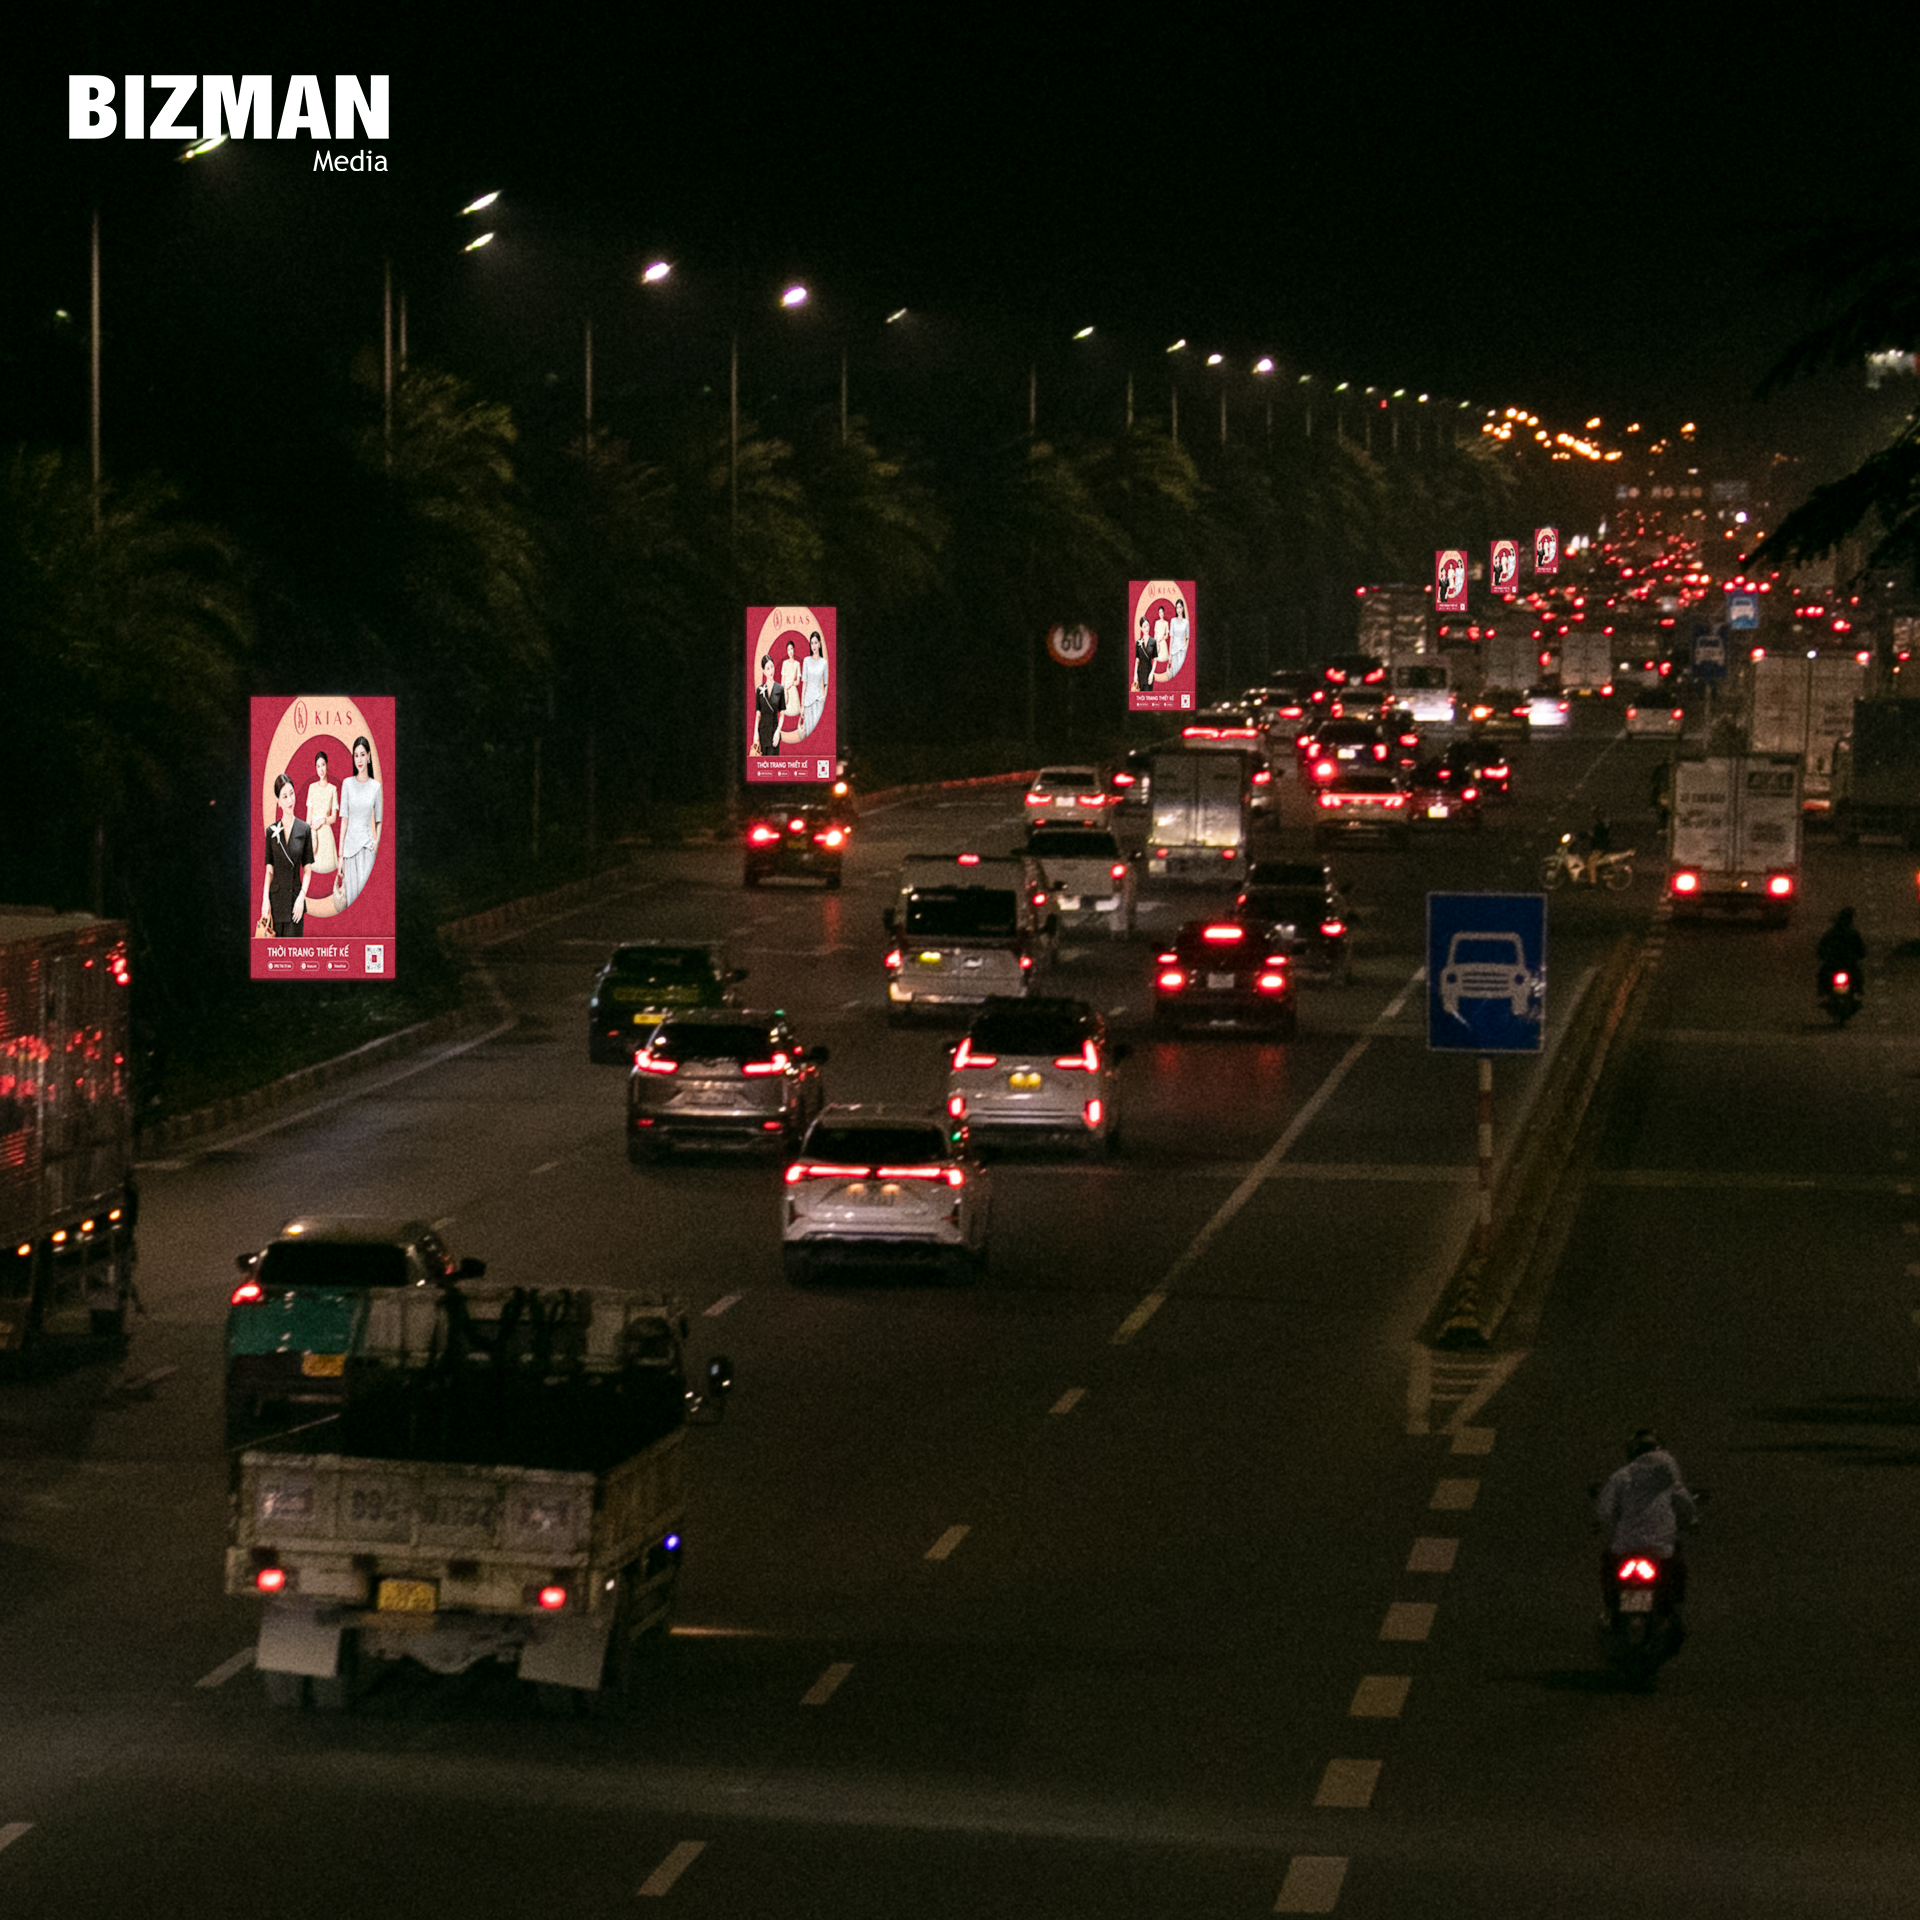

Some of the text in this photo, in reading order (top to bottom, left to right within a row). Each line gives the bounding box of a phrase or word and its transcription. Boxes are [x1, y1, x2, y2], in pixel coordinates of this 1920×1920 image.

[786, 615, 811, 625] KIAS
[1060, 630, 1084, 652] 60
[315, 710, 353, 726] KIAS
[267, 944, 350, 957] THỜI TRANG THIẾT KẾ
